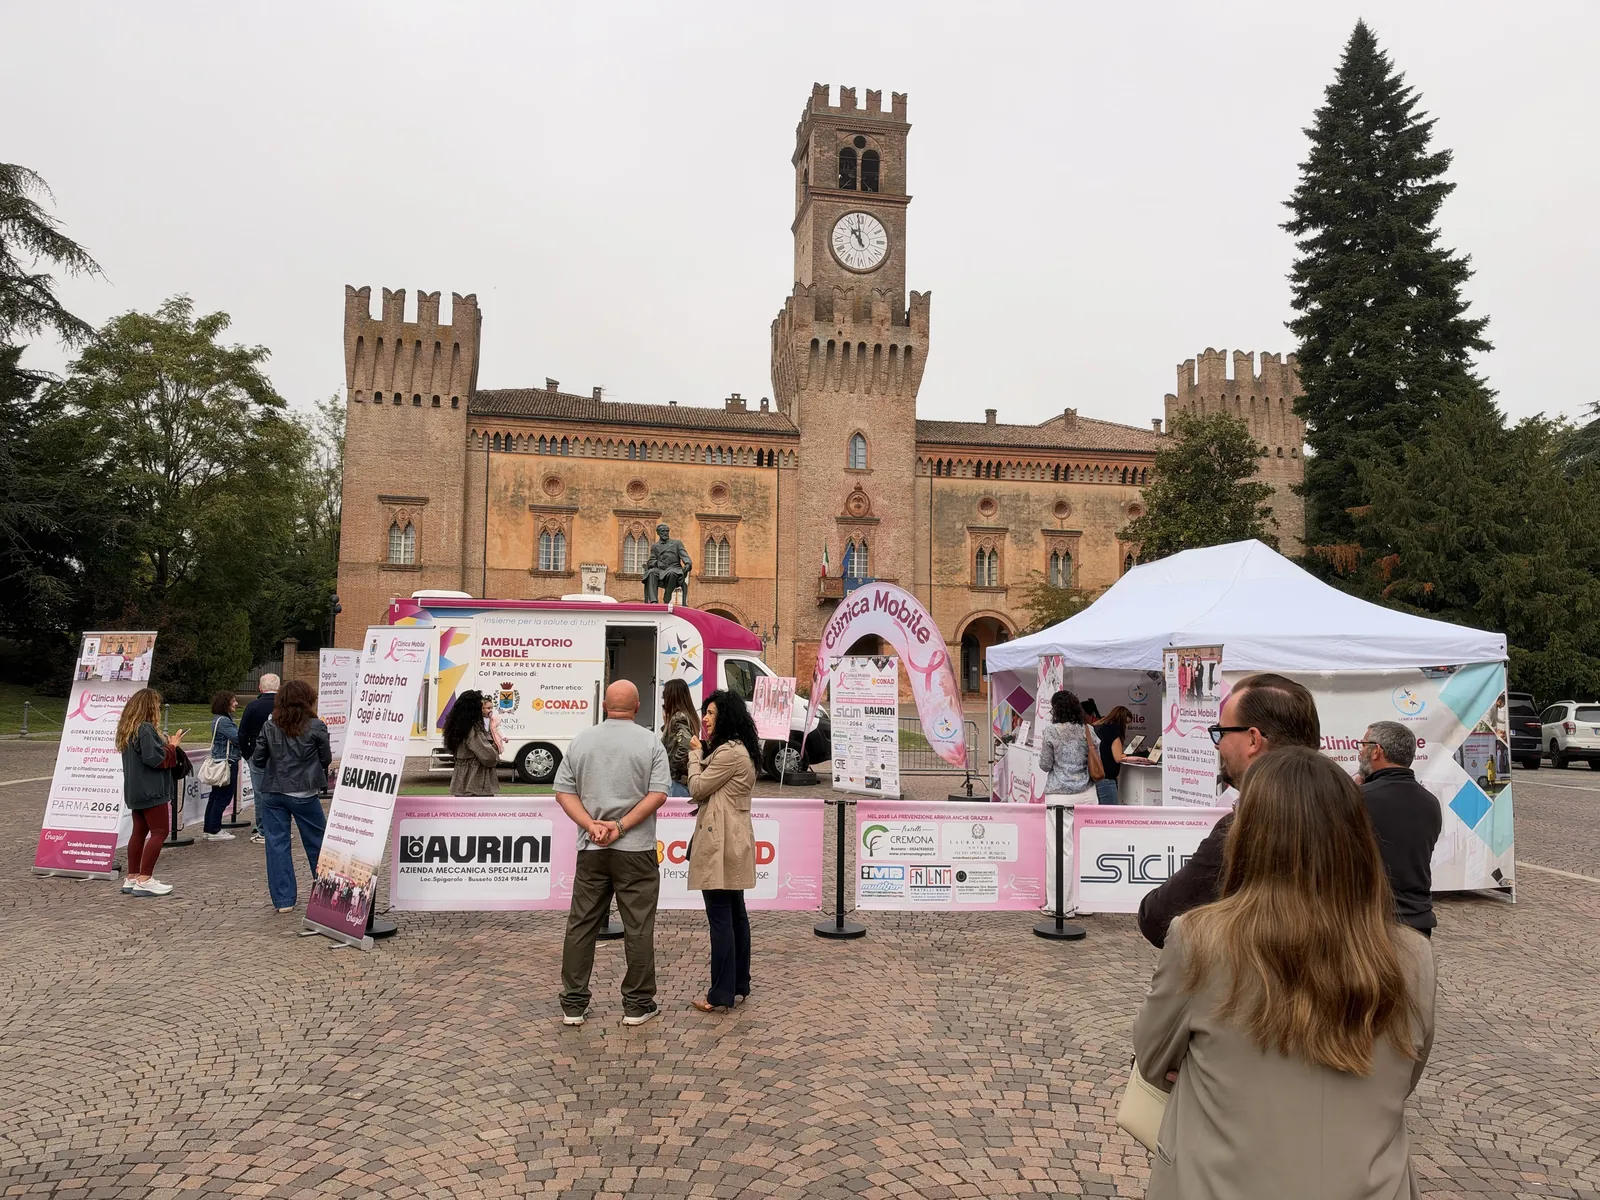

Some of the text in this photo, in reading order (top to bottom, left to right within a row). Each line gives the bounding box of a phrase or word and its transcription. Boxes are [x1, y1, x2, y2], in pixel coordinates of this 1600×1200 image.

[518, 618, 532, 626] per
[826, 590, 930, 650] Clinica Mobile
[481, 637, 573, 647] AMBULATORIO
[481, 649, 528, 658] MOBILE
[364, 673, 394, 685] Ottobre
[394, 674, 408, 686] ha
[91, 694, 132, 703] Clinica Mob
[360, 690, 393, 706] 31 giorni
[545, 700, 588, 710] CONAD
[357, 707, 404, 723] Oggi è il tuo
[834, 706, 861, 718] sicim
[865, 707, 895, 716] LAURINI
[1180, 708, 1217, 718] Clinica Mobile
[326, 716, 346, 725] CONAD
[362, 740, 388, 748] PREVENZIONE
[1319, 736, 1358, 750] Clinic
[364, 755, 388, 764] PROMOSSO
[1186, 769, 1214, 777] prevenzione
[341, 766, 398, 794] LAURINI
[44, 831, 66, 842] Grazie!
[890, 836, 934, 844] CREMONA
[400, 836, 551, 863] LAURINI
[663, 868, 688, 879] Perso
[346, 909, 365, 926] Grazie!
